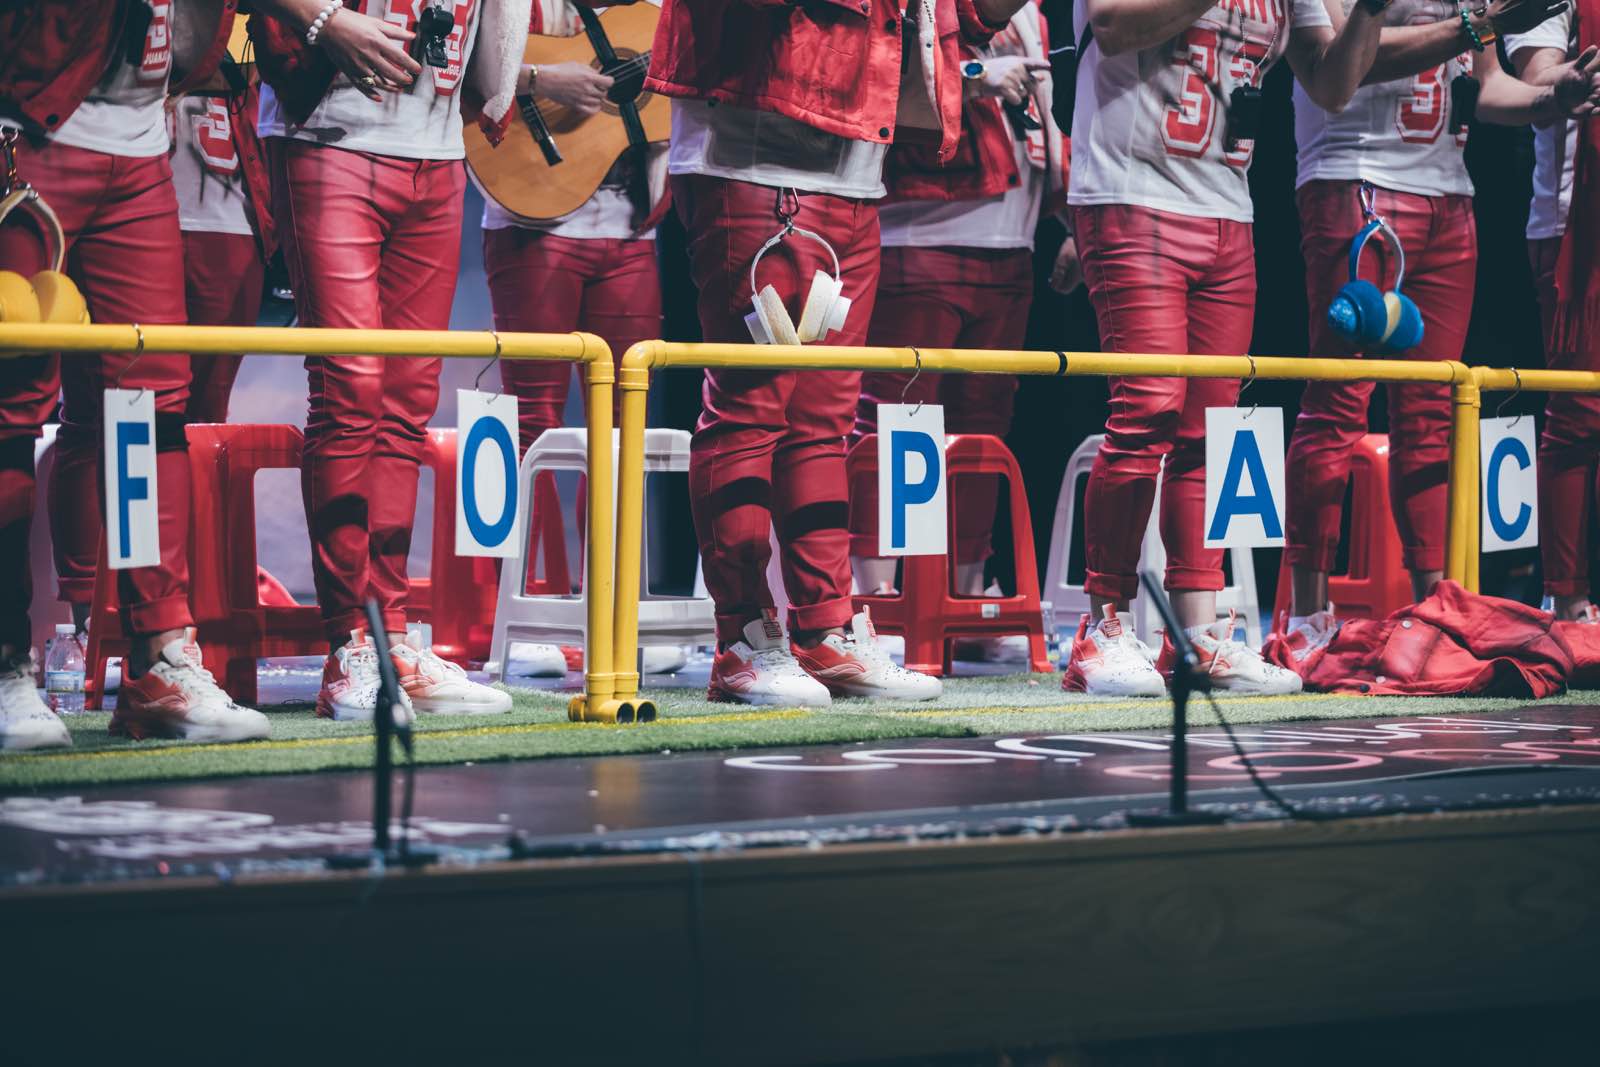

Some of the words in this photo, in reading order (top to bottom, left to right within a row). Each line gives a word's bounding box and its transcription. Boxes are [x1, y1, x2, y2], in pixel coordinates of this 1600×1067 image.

[116, 422, 150, 558] F
[462, 416, 518, 547] O
[891, 430, 940, 549] P
[1207, 429, 1283, 541] A
[1487, 437, 1532, 542] C
